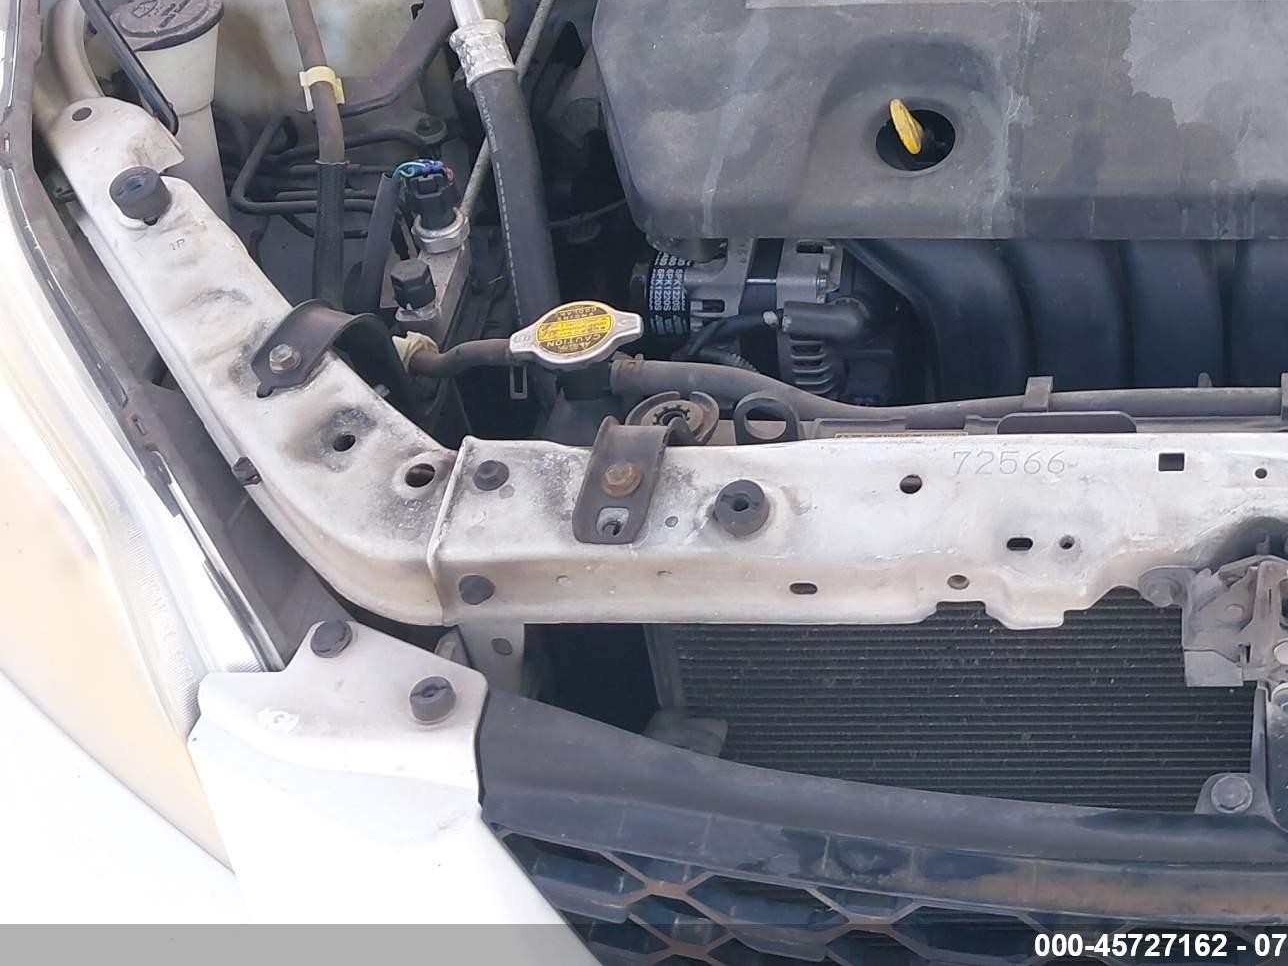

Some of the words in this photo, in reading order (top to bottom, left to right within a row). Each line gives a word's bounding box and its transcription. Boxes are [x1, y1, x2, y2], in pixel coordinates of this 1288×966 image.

[654, 268, 665, 311] 6PK1220S
[663, 268, 674, 311] 6PK1220S
[672, 268, 684, 311] 6PK1220S
[546, 333, 601, 347] CAUTION
[953, 450, 1065, 475] 72566
